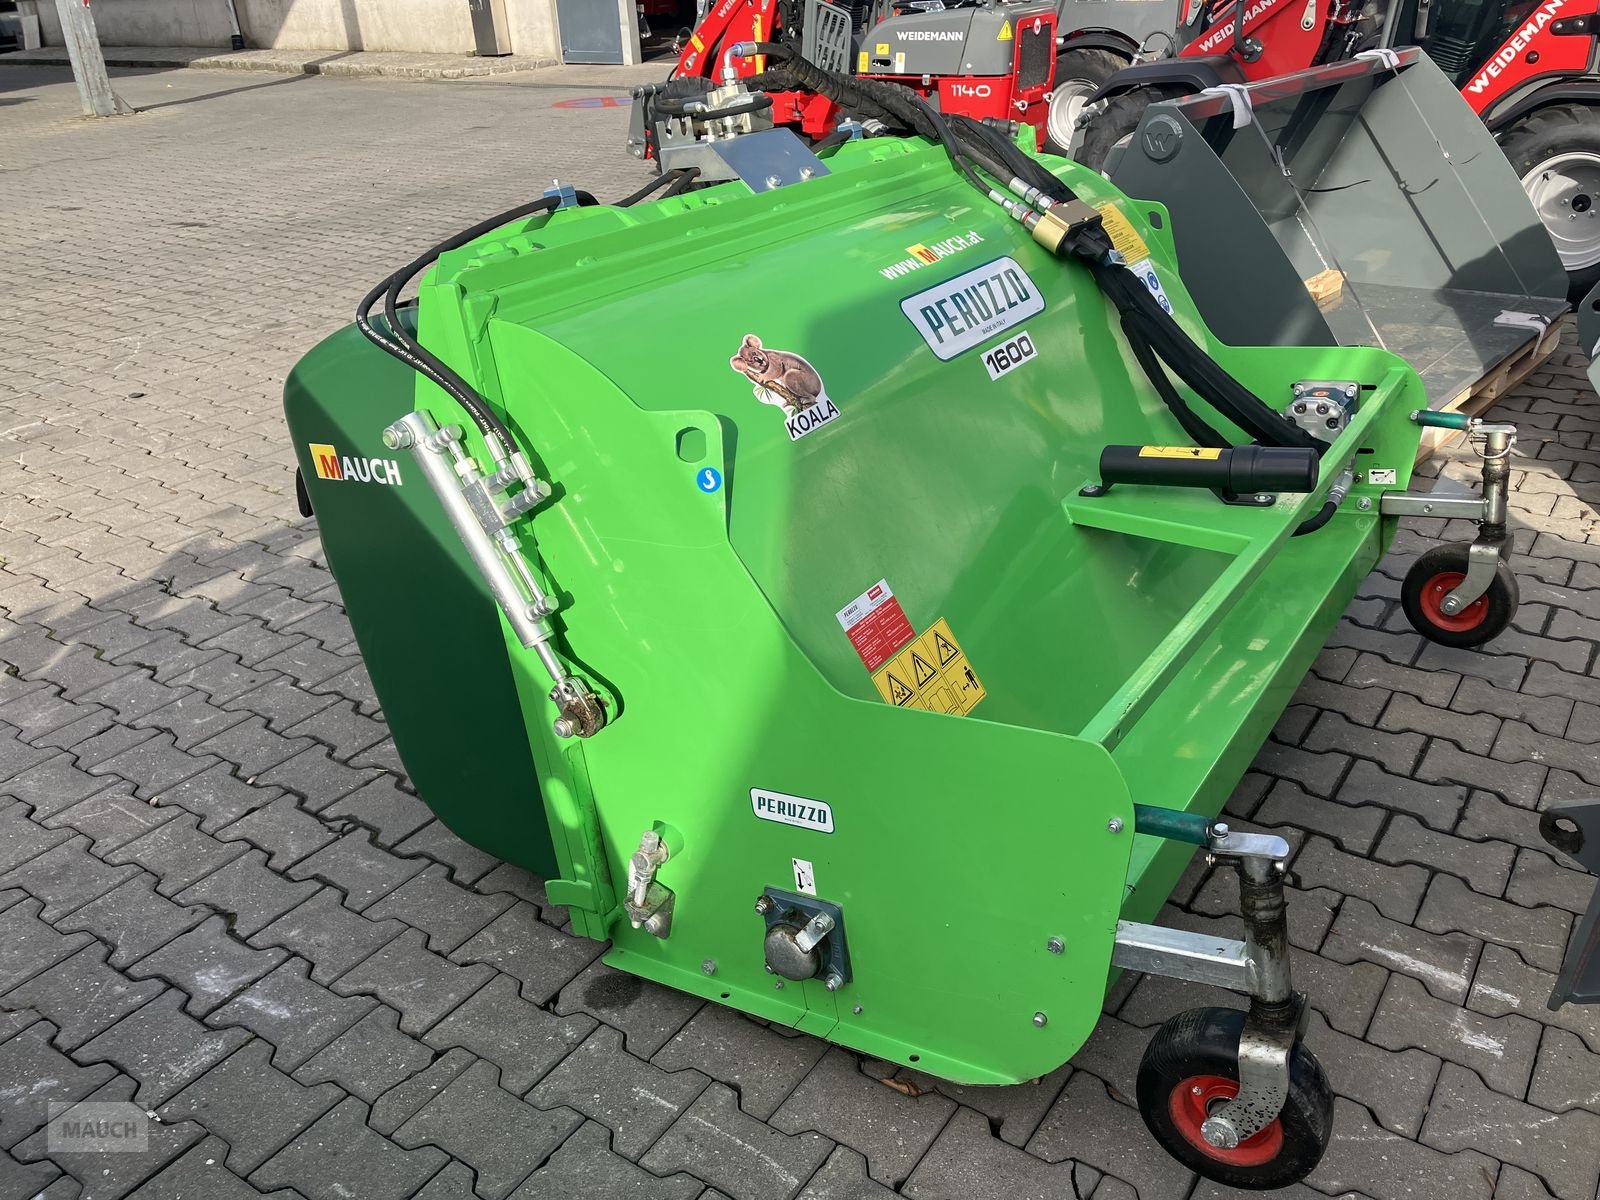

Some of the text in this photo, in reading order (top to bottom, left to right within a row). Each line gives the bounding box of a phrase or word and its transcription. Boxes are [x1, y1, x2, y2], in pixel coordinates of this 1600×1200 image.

[896, 31, 963, 41] WEIDEMANN
[1198, 0, 1277, 52] WEIDMAN
[1467, 0, 1568, 94] WEIDEMAN
[951, 84, 992, 97] 1140
[878, 229, 985, 281] www.MAUCH.at
[919, 268, 1031, 344] PERUZZO
[986, 335, 1035, 374] 1600
[786, 399, 839, 439] KOALA
[319, 454, 403, 486] MAUCH
[757, 796, 827, 824] PERUZZO
